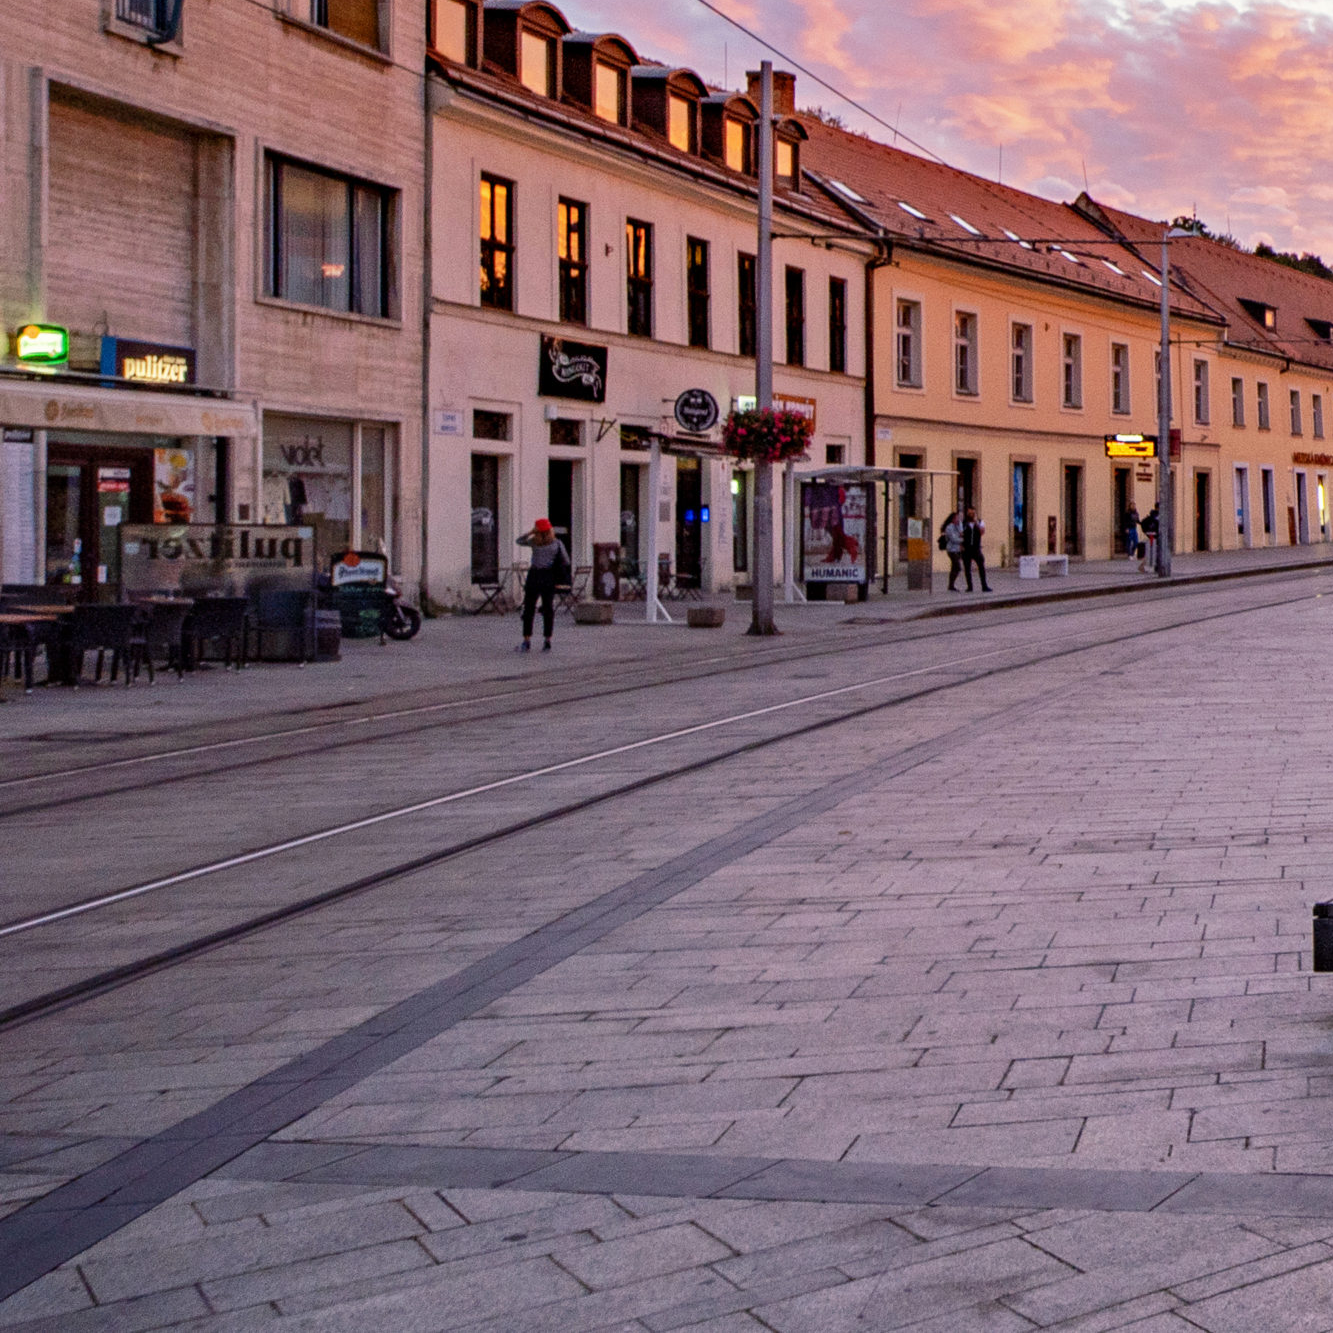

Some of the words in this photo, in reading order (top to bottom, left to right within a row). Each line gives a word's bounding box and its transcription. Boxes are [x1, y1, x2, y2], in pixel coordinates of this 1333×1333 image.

[124, 355, 187, 382] pulitzer
[280, 435, 325, 466] violet
[811, 567, 859, 579] HUMANIC
